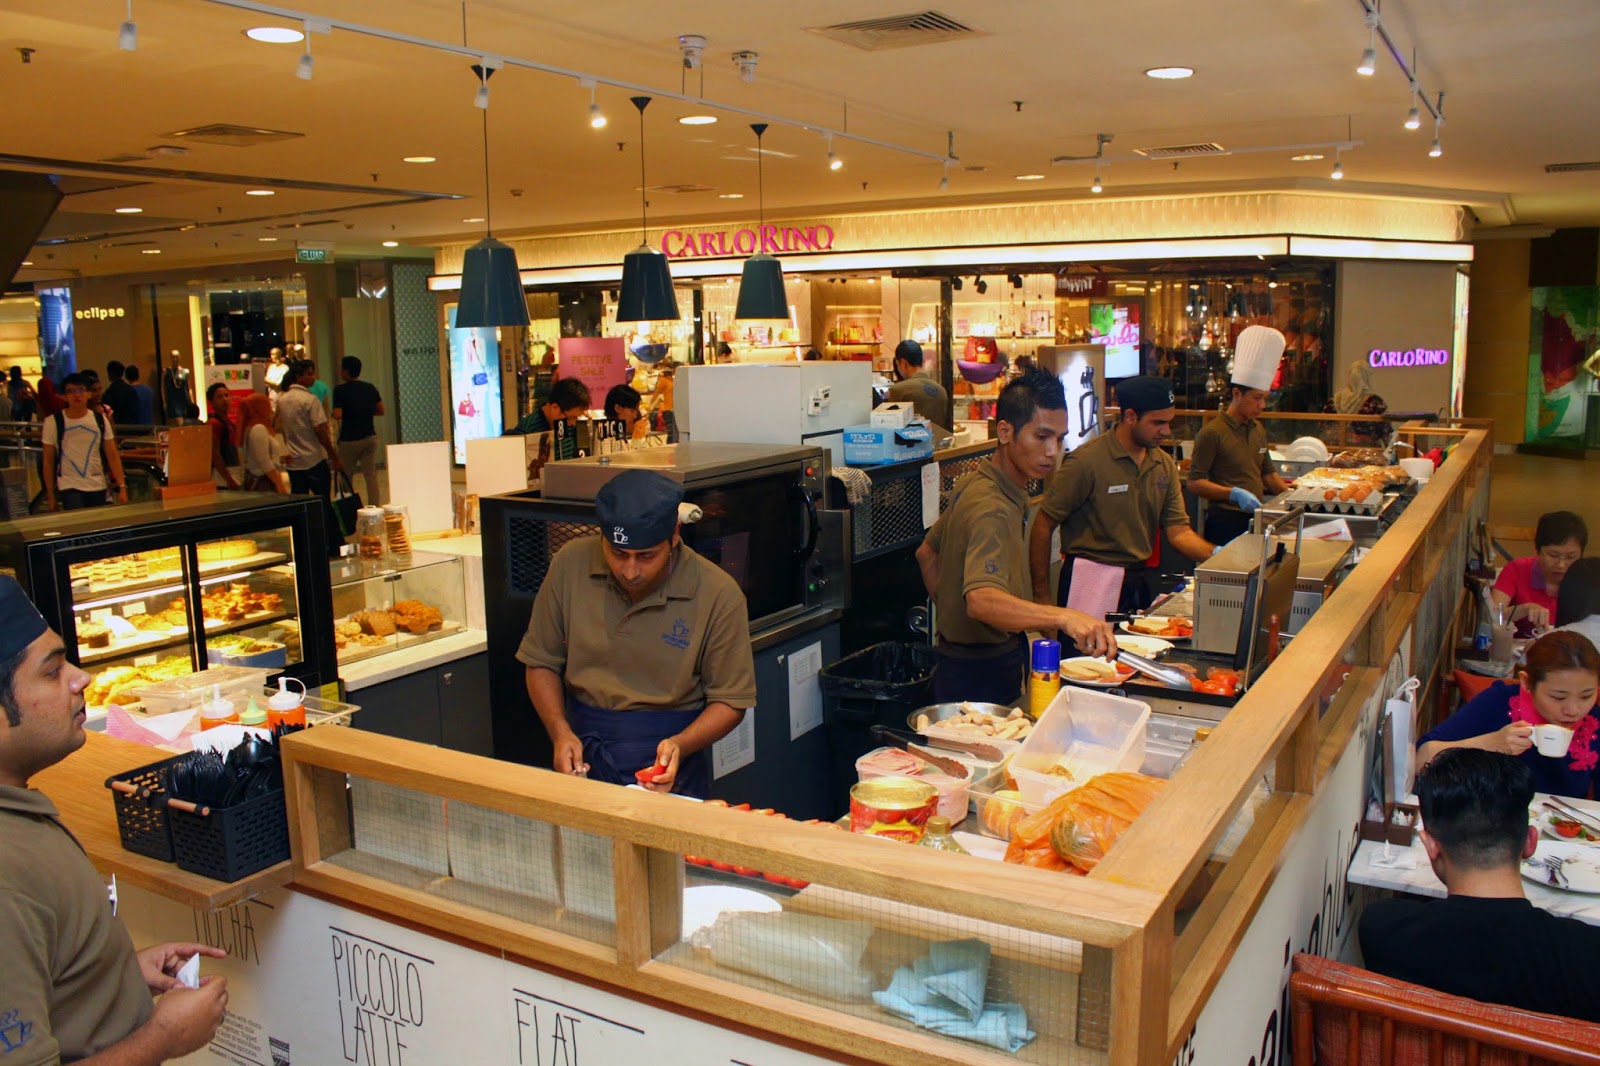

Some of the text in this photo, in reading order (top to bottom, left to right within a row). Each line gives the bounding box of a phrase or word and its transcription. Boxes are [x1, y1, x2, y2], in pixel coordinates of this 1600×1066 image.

[75, 307, 124, 320] eclipse
[571, 354, 613, 365] FESTIVE
[581, 367, 605, 376] SALE
[332, 935, 423, 1027] PICCOLO
[339, 999, 408, 1066] LATTE
[515, 998, 581, 1066] FLAT
